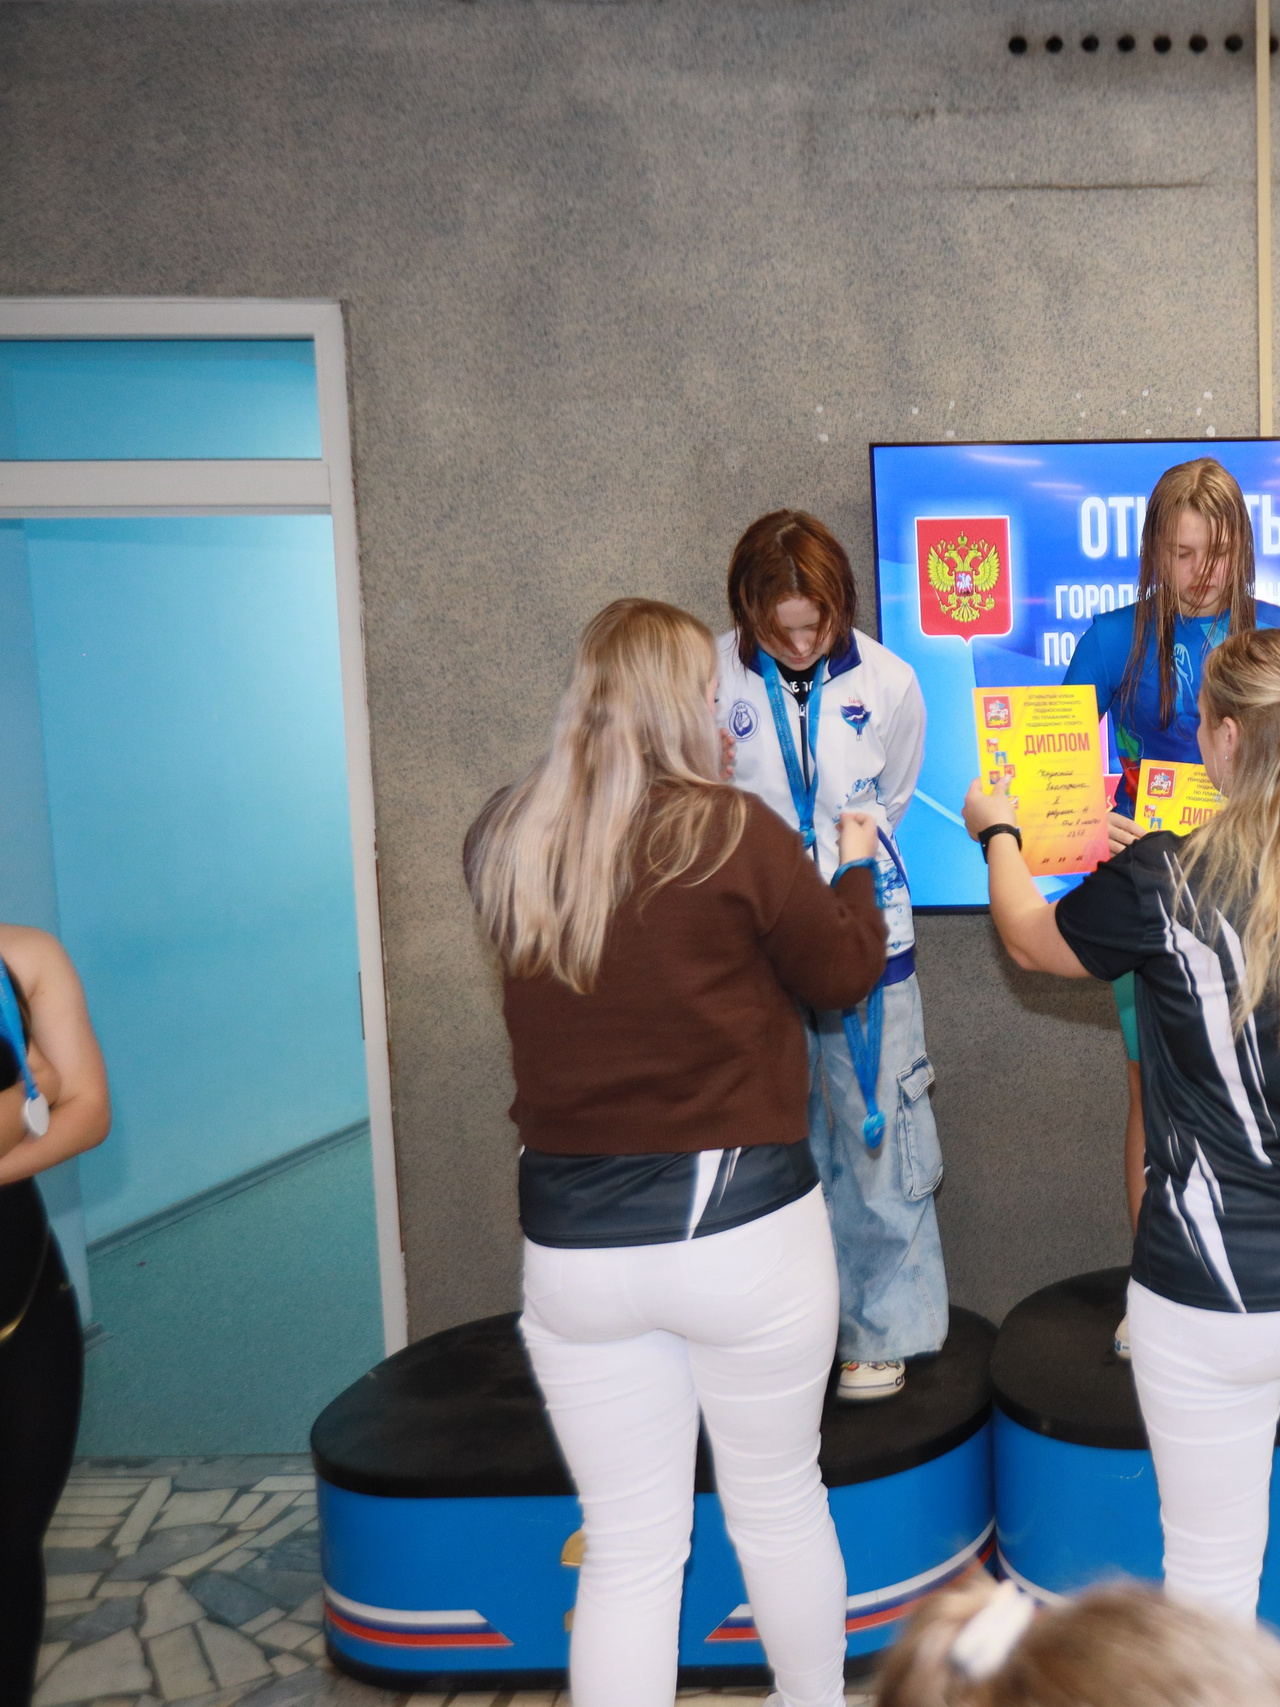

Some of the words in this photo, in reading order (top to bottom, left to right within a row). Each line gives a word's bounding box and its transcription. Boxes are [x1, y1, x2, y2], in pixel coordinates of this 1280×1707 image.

[1055, 583, 1157, 619] ГОРОД
[1043, 632, 1076, 666] ПО
[1024, 732, 1090, 756] ДИПЛОМ
[1179, 806, 1221, 826] ДИП
